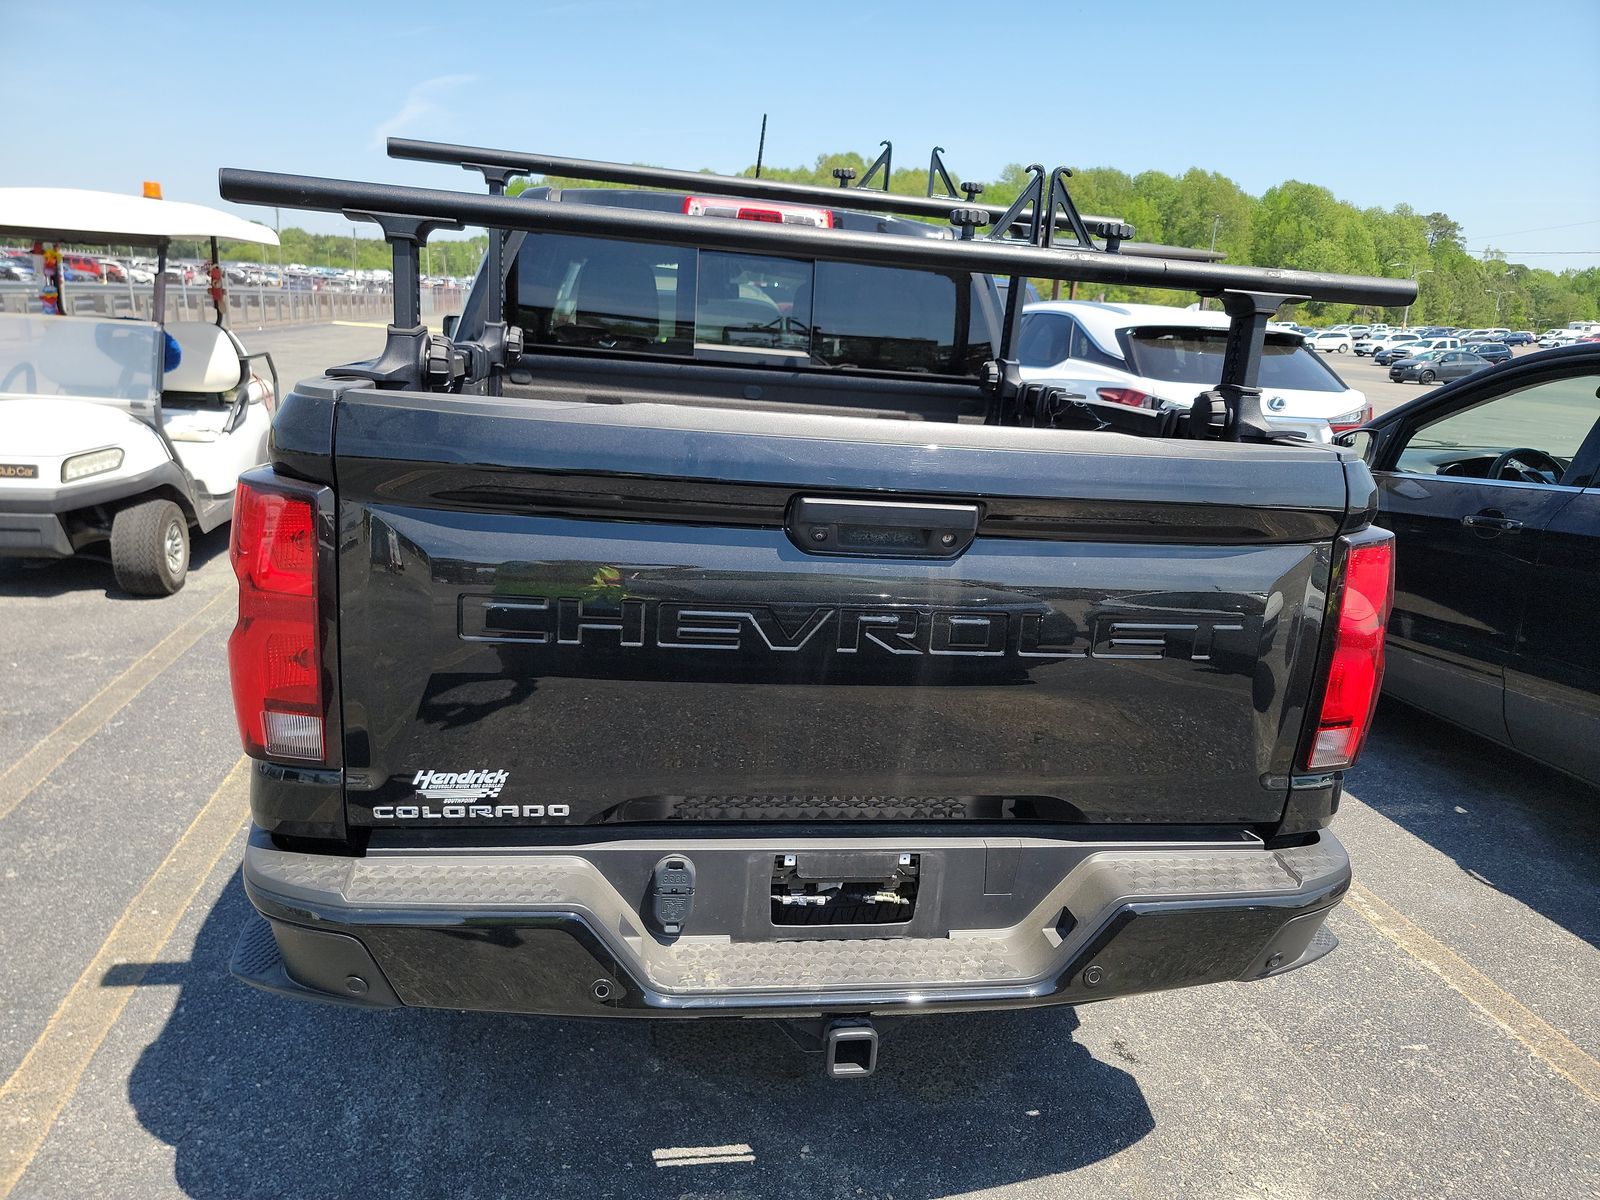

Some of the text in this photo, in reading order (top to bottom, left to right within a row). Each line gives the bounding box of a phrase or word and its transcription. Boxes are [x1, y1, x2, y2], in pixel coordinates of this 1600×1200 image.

[16, 466, 33, 477] Car
[457, 592, 1245, 660] CHEVROLET
[412, 769, 509, 789] Hendrick
[373, 804, 570, 819] COLORADO
